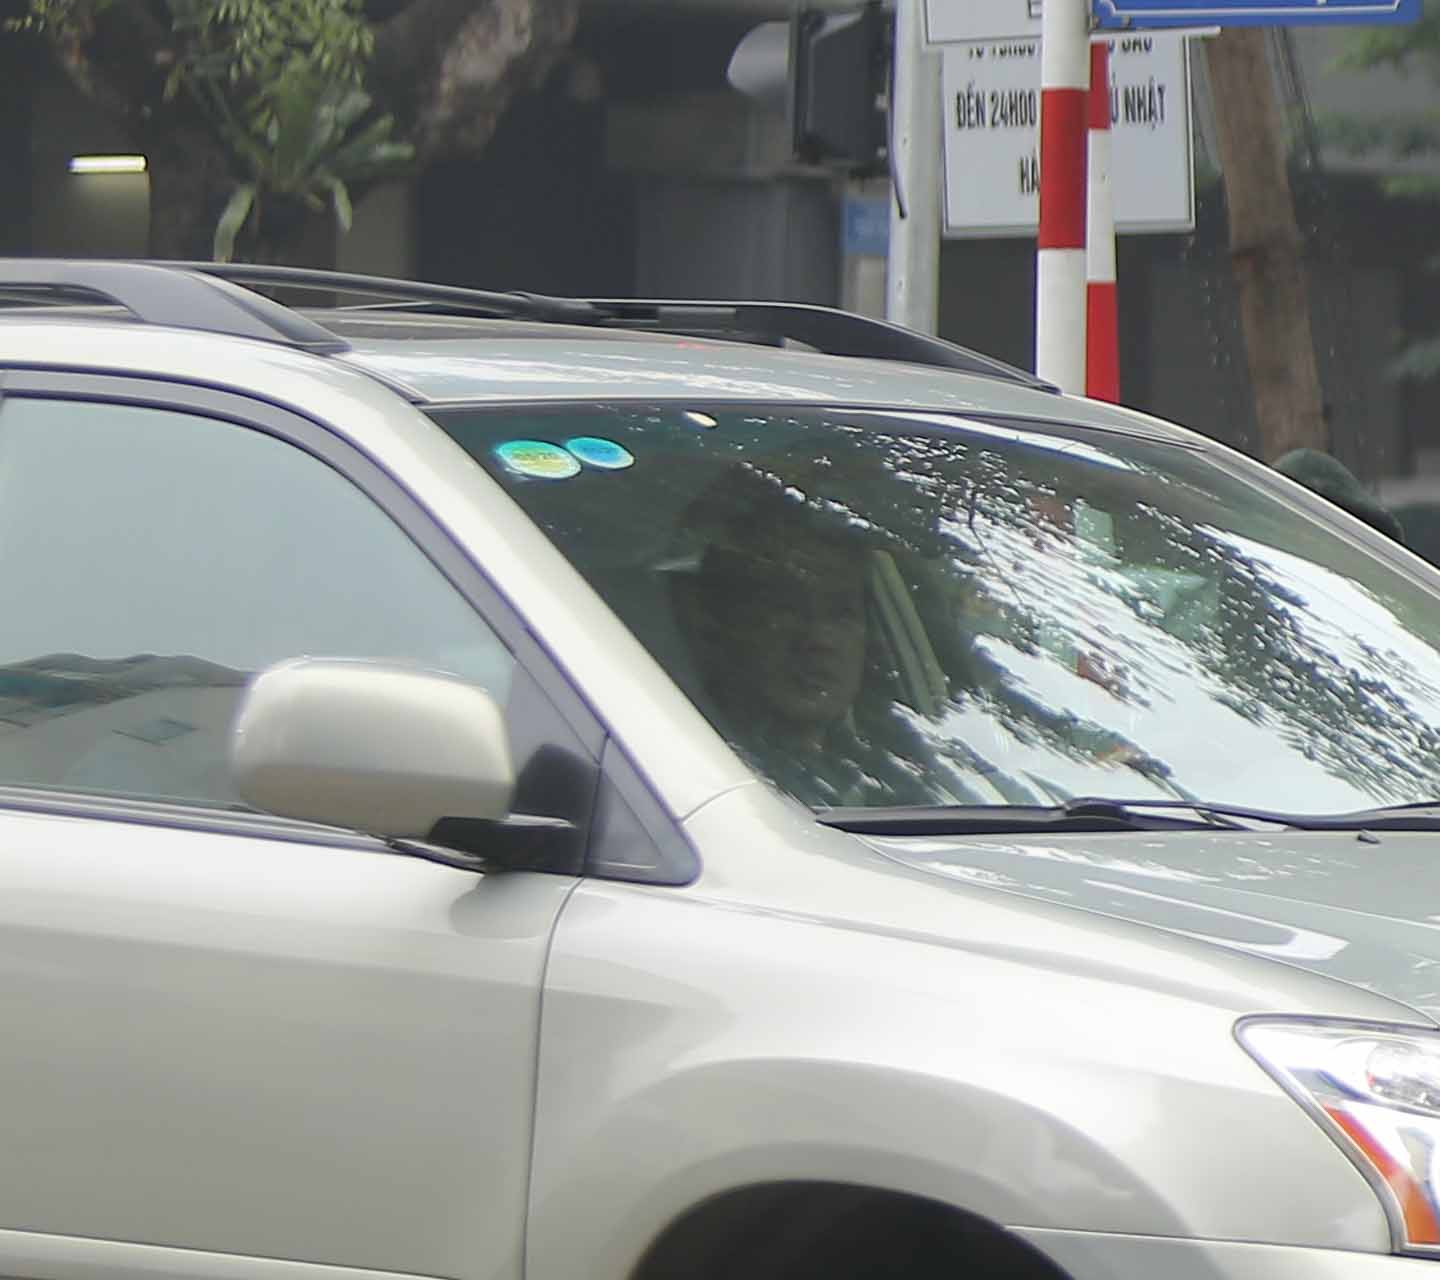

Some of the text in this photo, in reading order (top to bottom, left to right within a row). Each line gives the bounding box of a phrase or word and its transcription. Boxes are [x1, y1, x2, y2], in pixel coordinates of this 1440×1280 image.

[956, 79, 986, 129] ĐẾN
[990, 89, 1038, 128] 24H00
[1124, 77, 1167, 131] NHẬT
